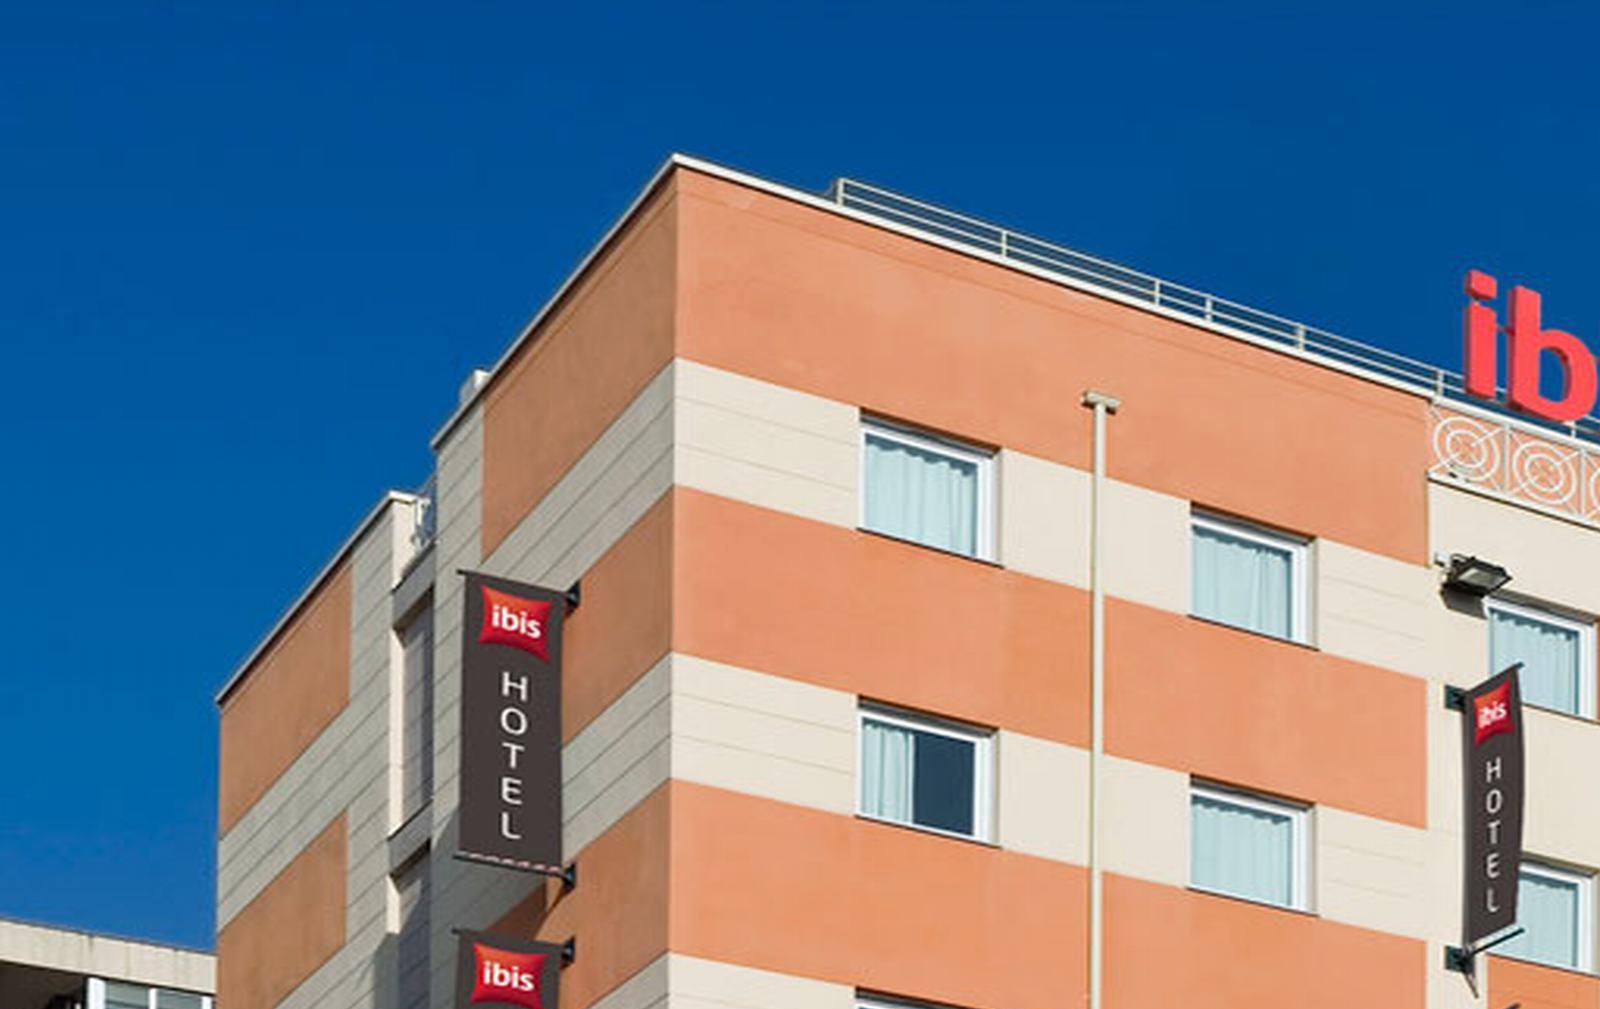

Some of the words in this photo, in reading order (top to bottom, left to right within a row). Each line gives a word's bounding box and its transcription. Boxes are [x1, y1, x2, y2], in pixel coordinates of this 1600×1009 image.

[492, 605, 541, 639] ibis
[1478, 702, 1507, 729] ibis
[501, 671, 528, 839] HOTEL
[1486, 757, 1502, 913] HOTEL
[482, 961, 534, 992] ibis
